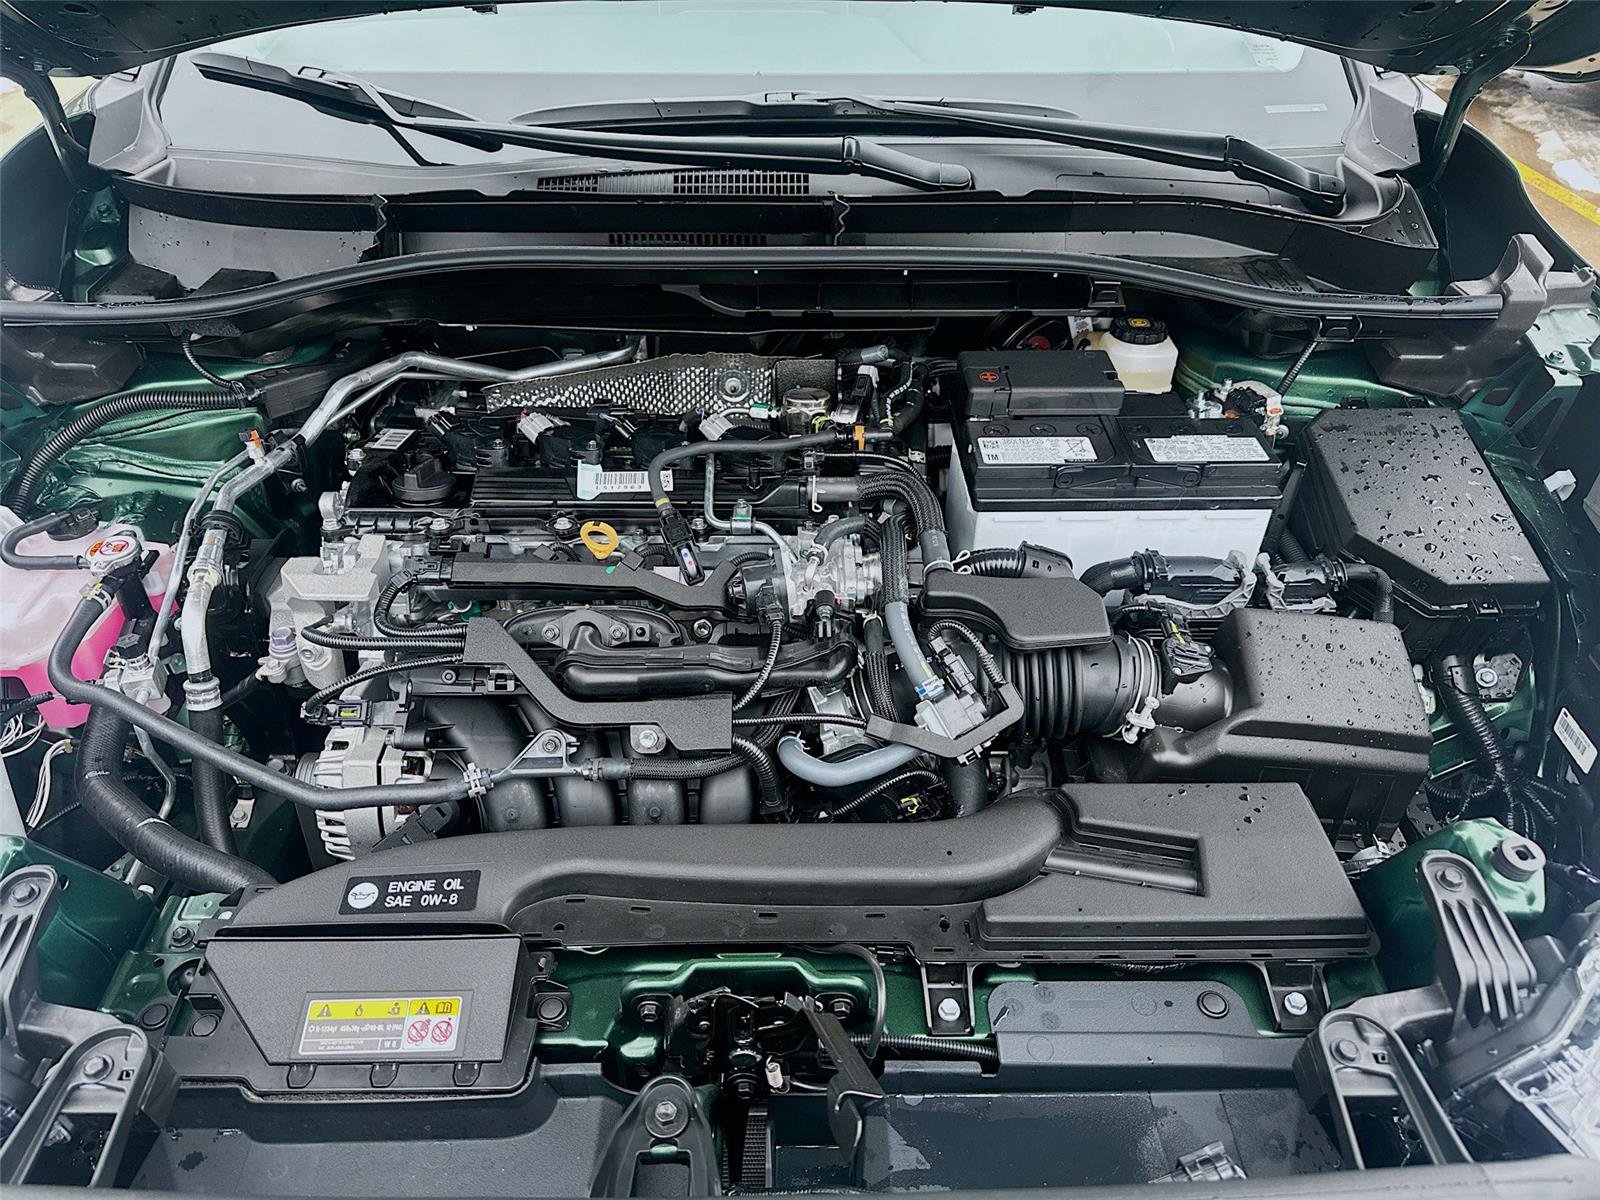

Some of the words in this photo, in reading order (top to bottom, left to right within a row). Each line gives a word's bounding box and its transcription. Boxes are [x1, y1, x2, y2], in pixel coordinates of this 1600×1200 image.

[986, 453, 999, 461] TM
[387, 879, 436, 893] ENGINE
[443, 878, 465, 891] OIL
[384, 895, 413, 908] SAE
[420, 893, 458, 906] 0W-8
